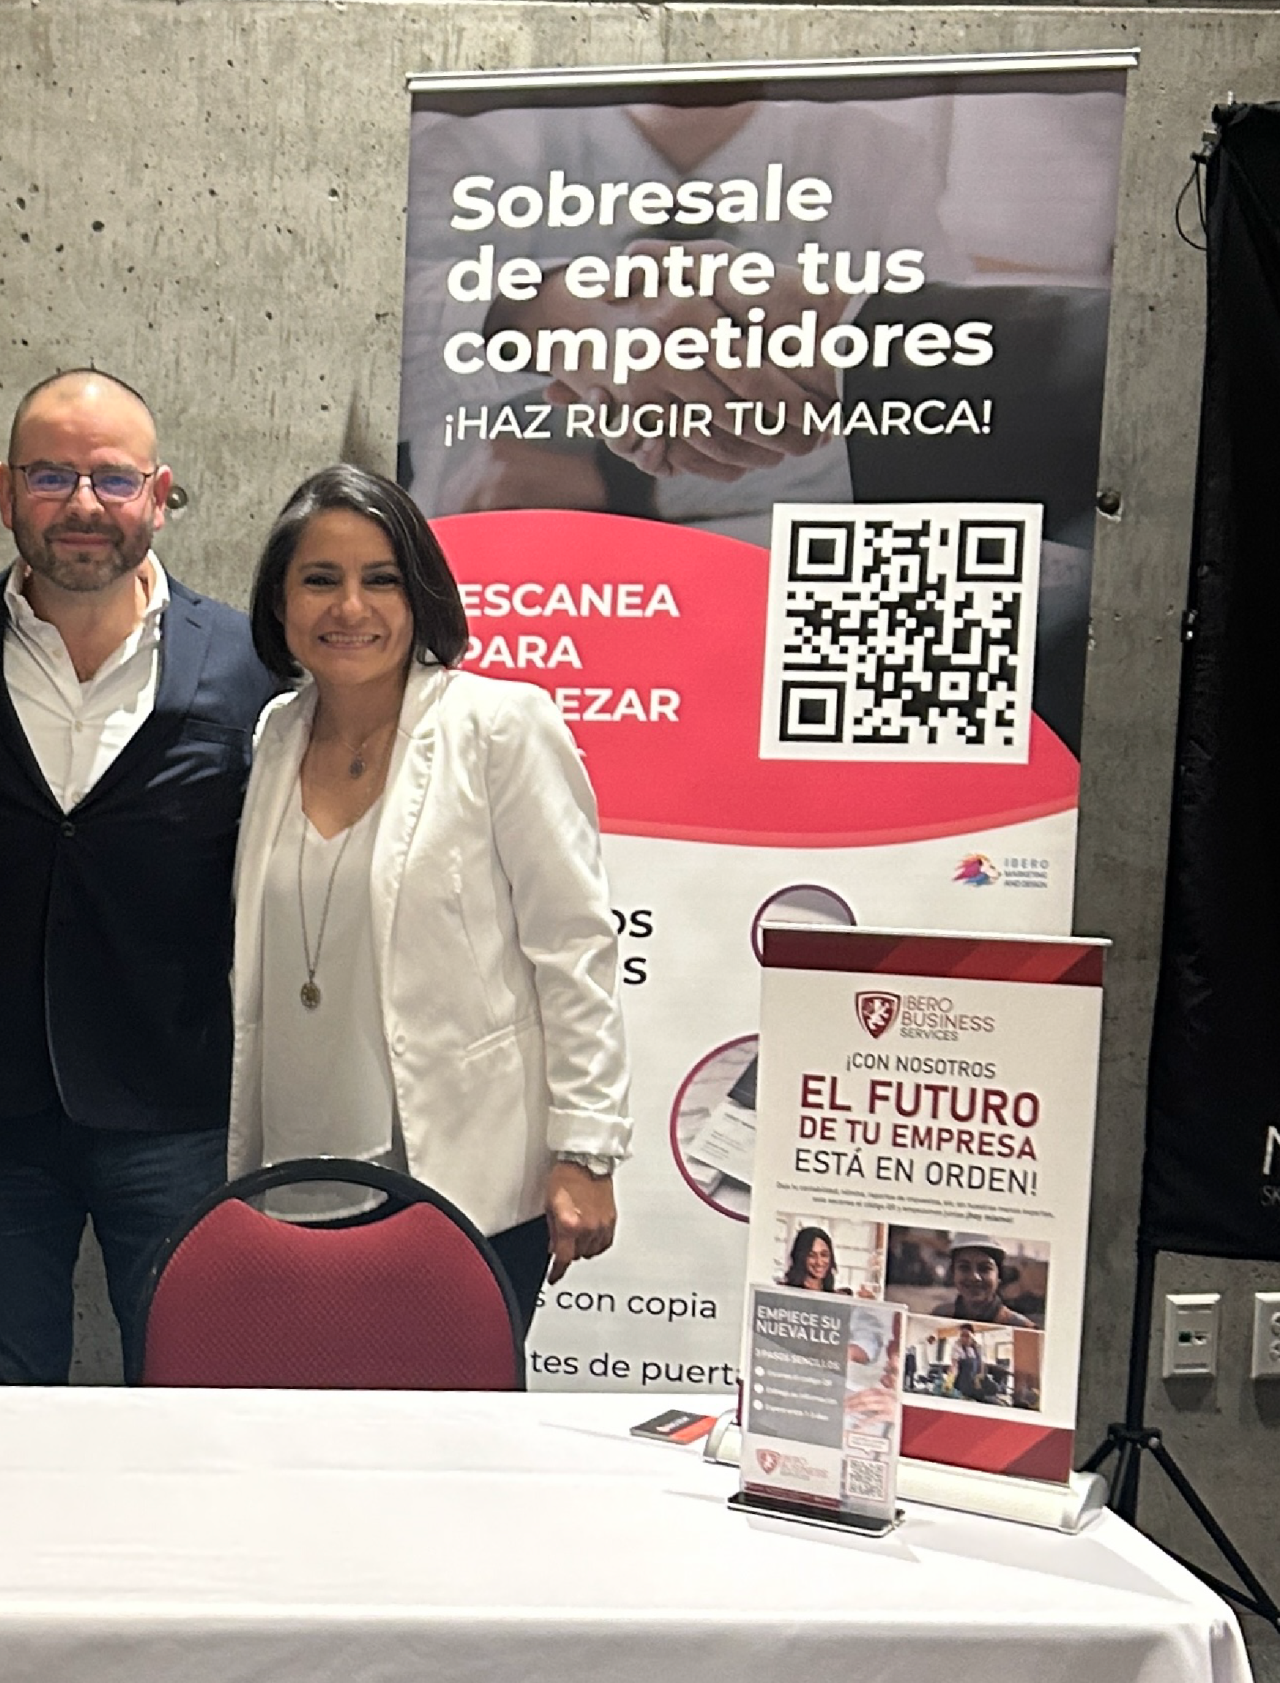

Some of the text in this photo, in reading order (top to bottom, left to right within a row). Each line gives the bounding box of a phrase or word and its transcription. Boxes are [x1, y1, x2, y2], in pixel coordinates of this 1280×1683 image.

[450, 162, 833, 231] Sobresale
[446, 242, 926, 302] de entre tus
[442, 308, 995, 384] competidores
[443, 398, 992, 447] ¡HAZ RUGIR TU MARCA!
[456, 583, 681, 618] ESCANEA
[555, 687, 682, 722] EZAR
[1003, 857, 1049, 869] IBERO
[903, 994, 954, 1014] IBERO
[899, 1027, 959, 1042] SERVICES
[901, 1010, 995, 1033] BUSINESS
[846, 1052, 997, 1080] ¡CON NOSOTROS
[800, 1073, 1041, 1129] EL FUTURO
[799, 1115, 1038, 1162] DE TU EMPRESA
[795, 1147, 1038, 1197] ESTÁ EN ORDEN!
[555, 1291, 616, 1313] con
[627, 1292, 717, 1323] copia
[757, 1305, 841, 1332] EMPIECE SU
[756, 1319, 841, 1346] NUEVA LLC
[589, 1353, 630, 1378] de
[641, 1361, 740, 1386] puert
